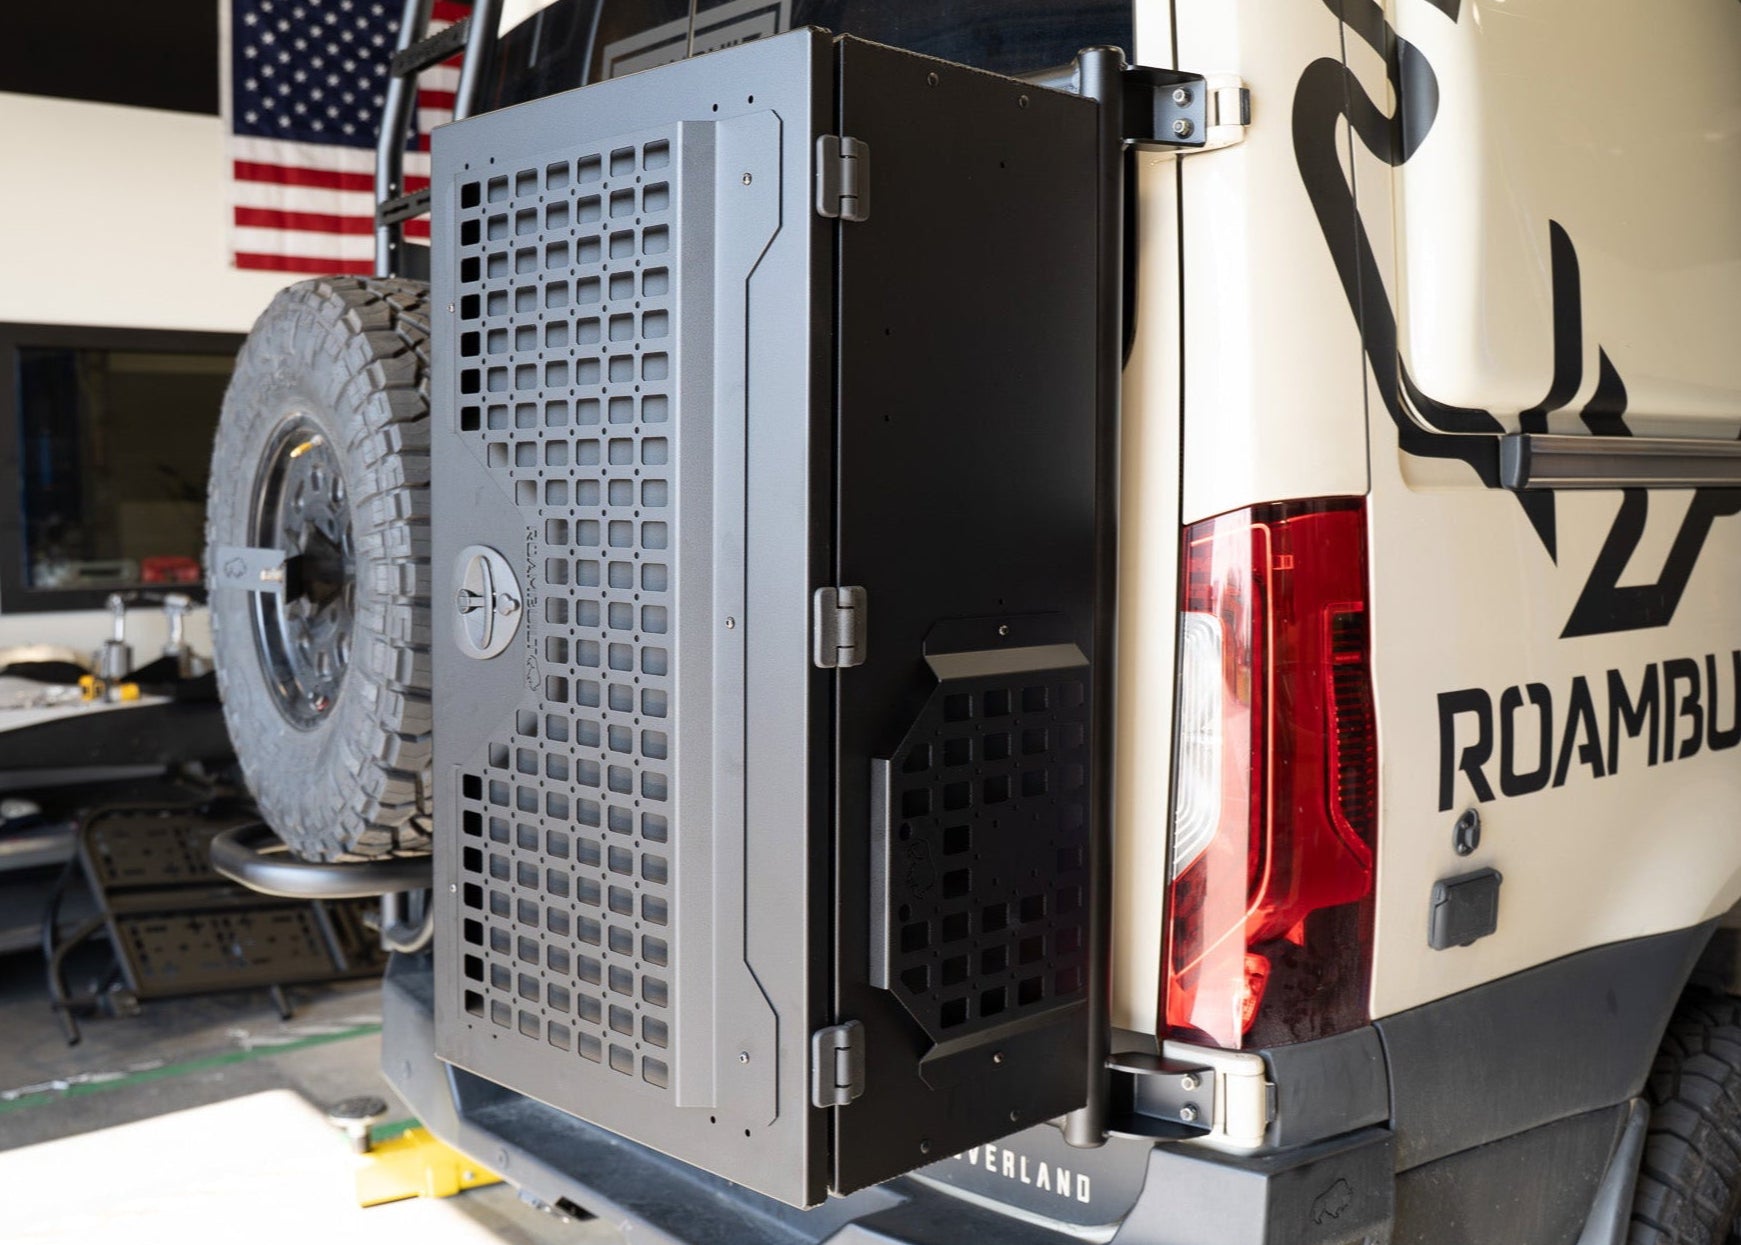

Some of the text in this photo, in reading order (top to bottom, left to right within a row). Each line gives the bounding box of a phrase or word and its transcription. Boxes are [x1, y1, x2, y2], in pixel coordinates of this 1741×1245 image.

[526, 525, 538, 655] ROAMBUILT
[1437, 650, 1741, 812] ROAMBU
[953, 1143, 1090, 1204] VERLAND
